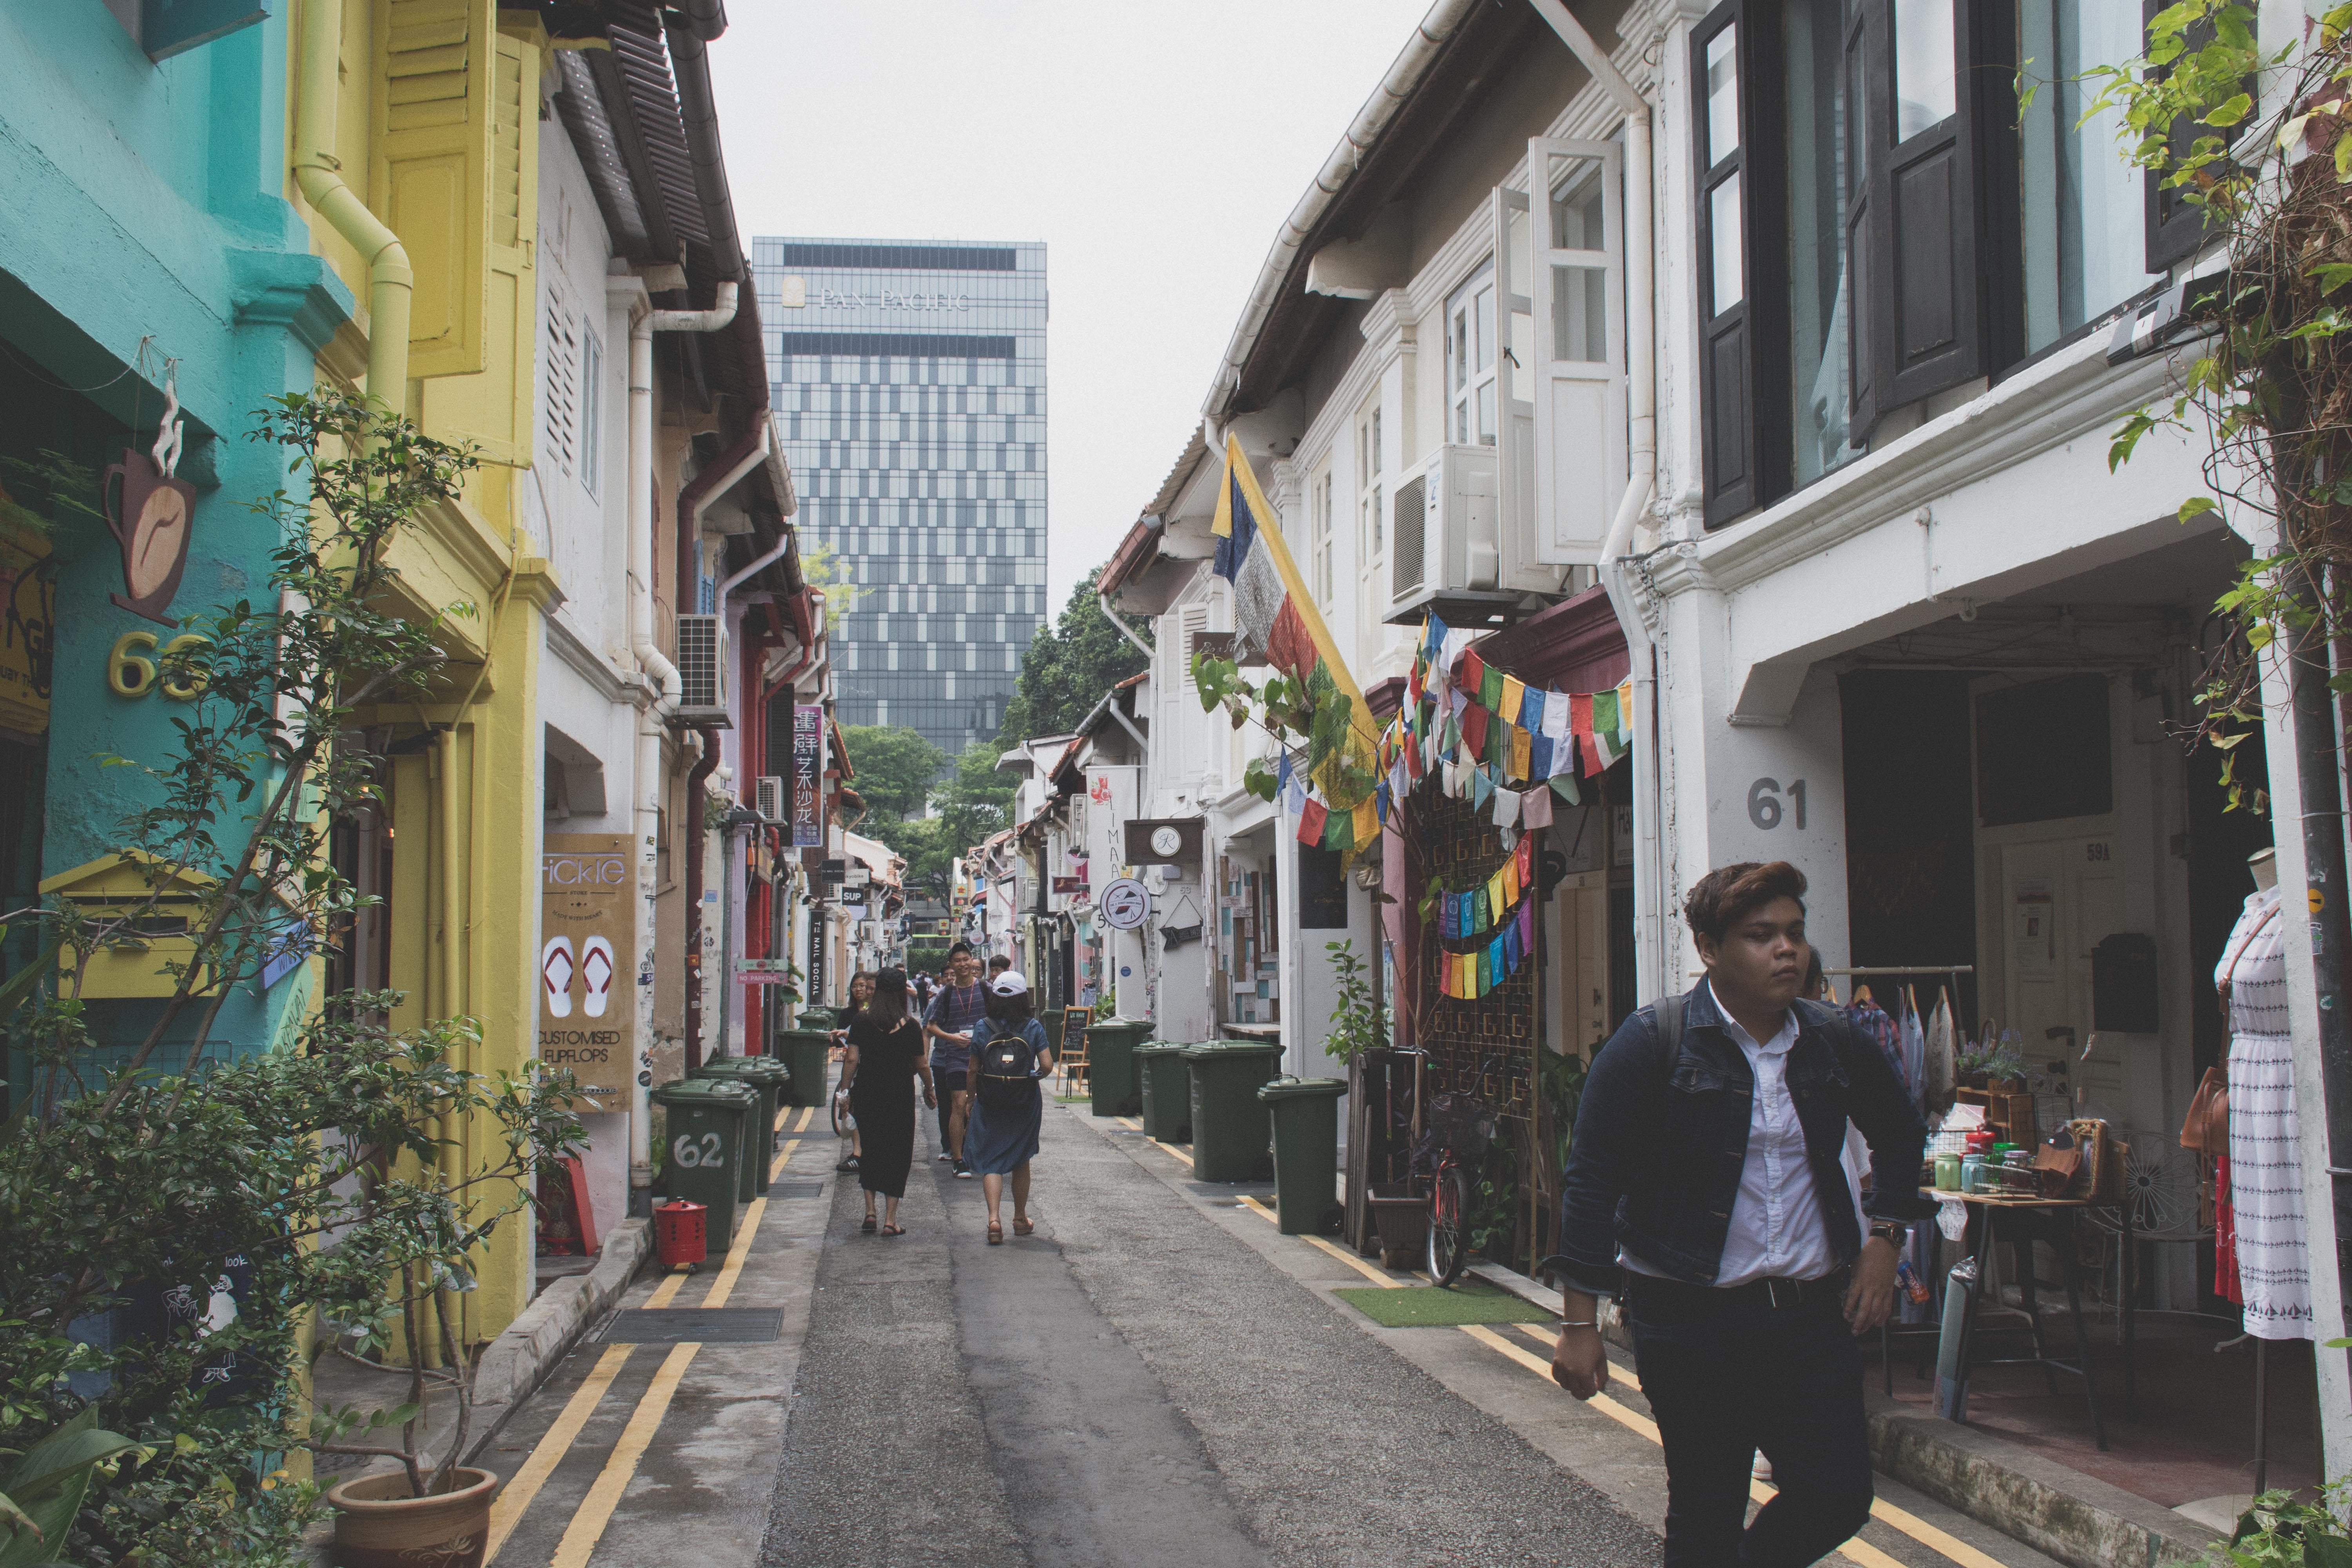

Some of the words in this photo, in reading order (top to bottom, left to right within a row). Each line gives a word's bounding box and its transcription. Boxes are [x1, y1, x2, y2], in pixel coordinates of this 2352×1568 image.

[819, 289, 867, 310] PAN
[879, 290, 970, 312] PACIFIC
[1747, 777, 1806, 830] 61
[1108, 795, 1120, 878] LIMAA
[2087, 843, 2109, 861] 59A
[543, 858, 625, 885] ickle
[843, 892, 861, 901] SUP
[544, 1048, 608, 1063] FLIPFLOPS
[673, 1132, 724, 1168] 62
[225, 1254, 249, 1268] look
